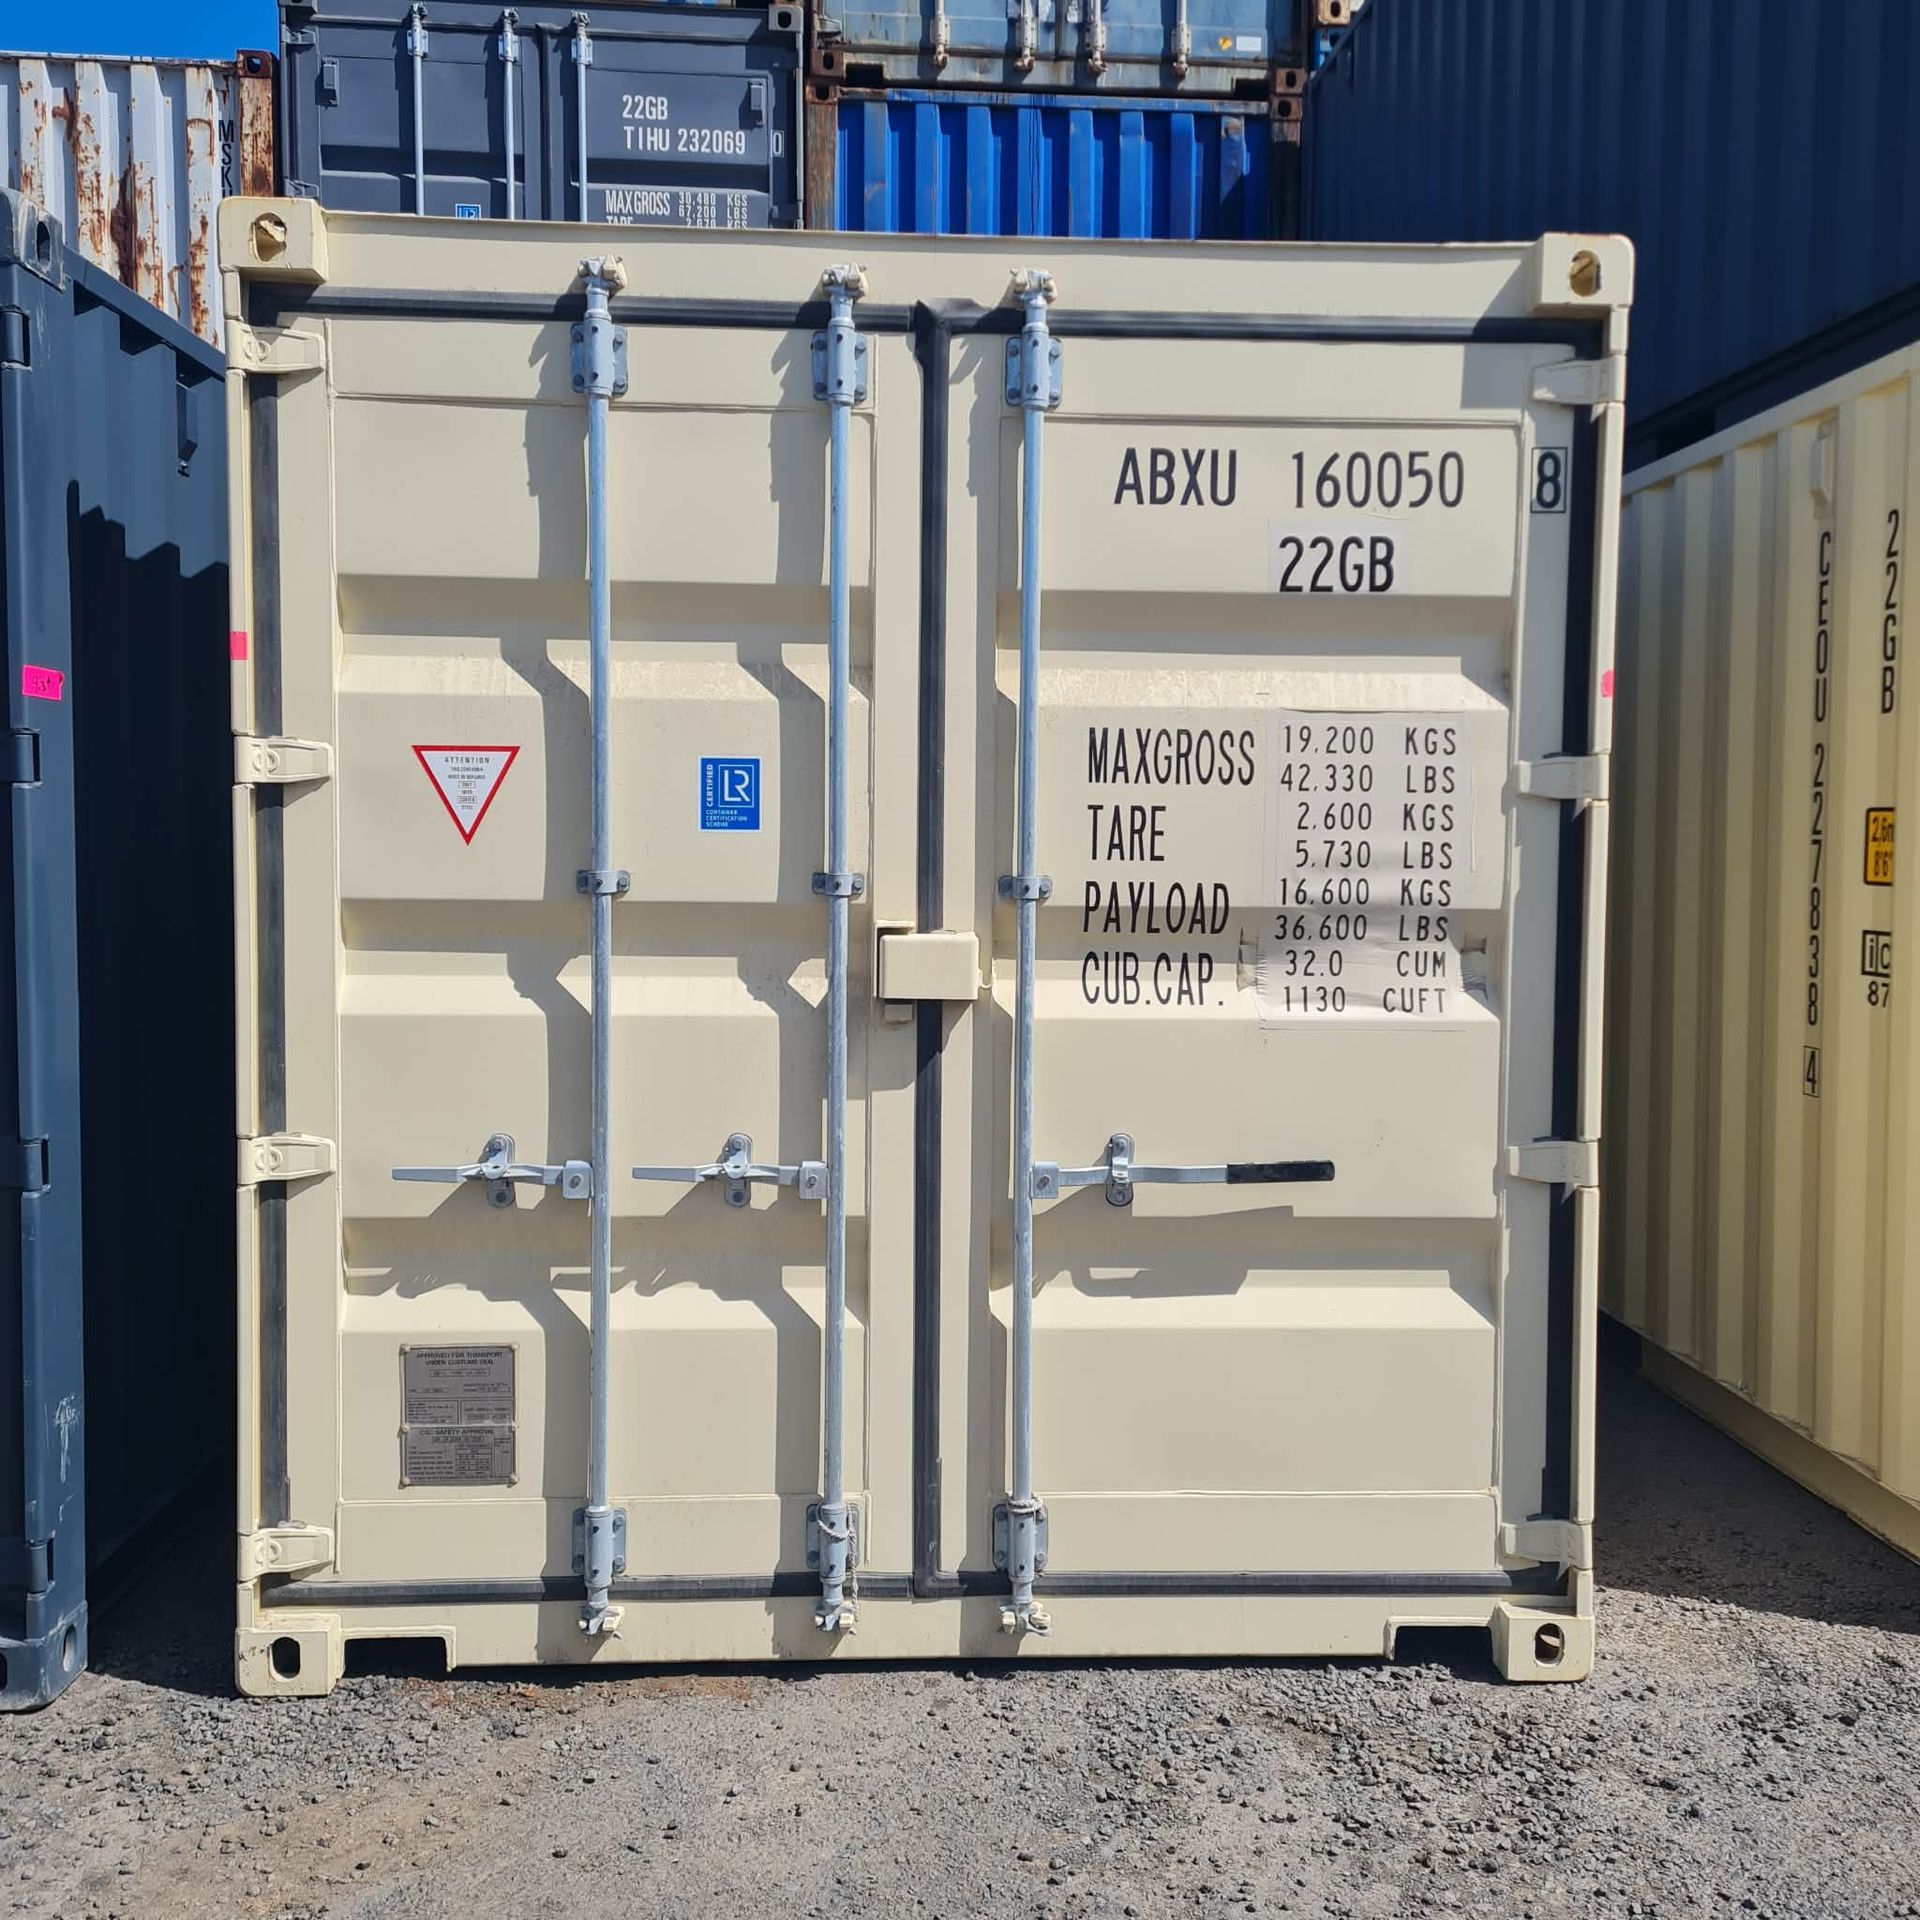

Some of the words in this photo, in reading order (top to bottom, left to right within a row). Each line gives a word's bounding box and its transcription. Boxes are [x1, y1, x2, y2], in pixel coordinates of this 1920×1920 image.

[623, 95, 667, 119] 22GB
[624, 126, 669, 151] TIHU
[678, 129, 745, 154] 232069
[606, 191, 669, 214] MAXGROSS
[727, 193, 747, 207] KGS
[727, 206, 747, 219] LBS
[1114, 448, 1236, 506] ABXU
[1293, 452, 1463, 508] 160050
[1536, 452, 1562, 508] 8
[1280, 537, 1393, 592] 22GB
[1815, 532, 1830, 722] CEOU
[1882, 510, 1899, 713] 22GB
[444, 756, 490, 764] ATTENTION
[1089, 728, 1254, 785] MAXGROSS
[1286, 726, 1373, 754] 19,200
[1406, 728, 1455, 755] KGS
[724, 769, 751, 802] LR
[1281, 764, 1372, 792] 42,330
[1407, 766, 1454, 793] LBS
[1088, 805, 1166, 861] TARE
[1298, 802, 1371, 830] 2,600
[1404, 804, 1453, 831] KGS
[1297, 840, 1370, 868] 5,730
[1404, 842, 1451, 869] LBS
[1808, 743, 1824, 1025] 227838
[1084, 882, 1229, 934] PAYLOAD
[1282, 878, 1368, 905] 16,600
[1401, 879, 1450, 906] KGS
[1275, 915, 1366, 940] 36,600
[1400, 915, 1448, 941] LBS
[1082, 951, 1222, 1005] CUB.CAP.
[1286, 950, 1342, 976] 32.0
[1397, 951, 1445, 976] CUM
[1868, 981, 1889, 1007] 87
[1285, 986, 1345, 1011] 1130
[1383, 988, 1444, 1012] CUFT
[1805, 1051, 1818, 1094] 4
